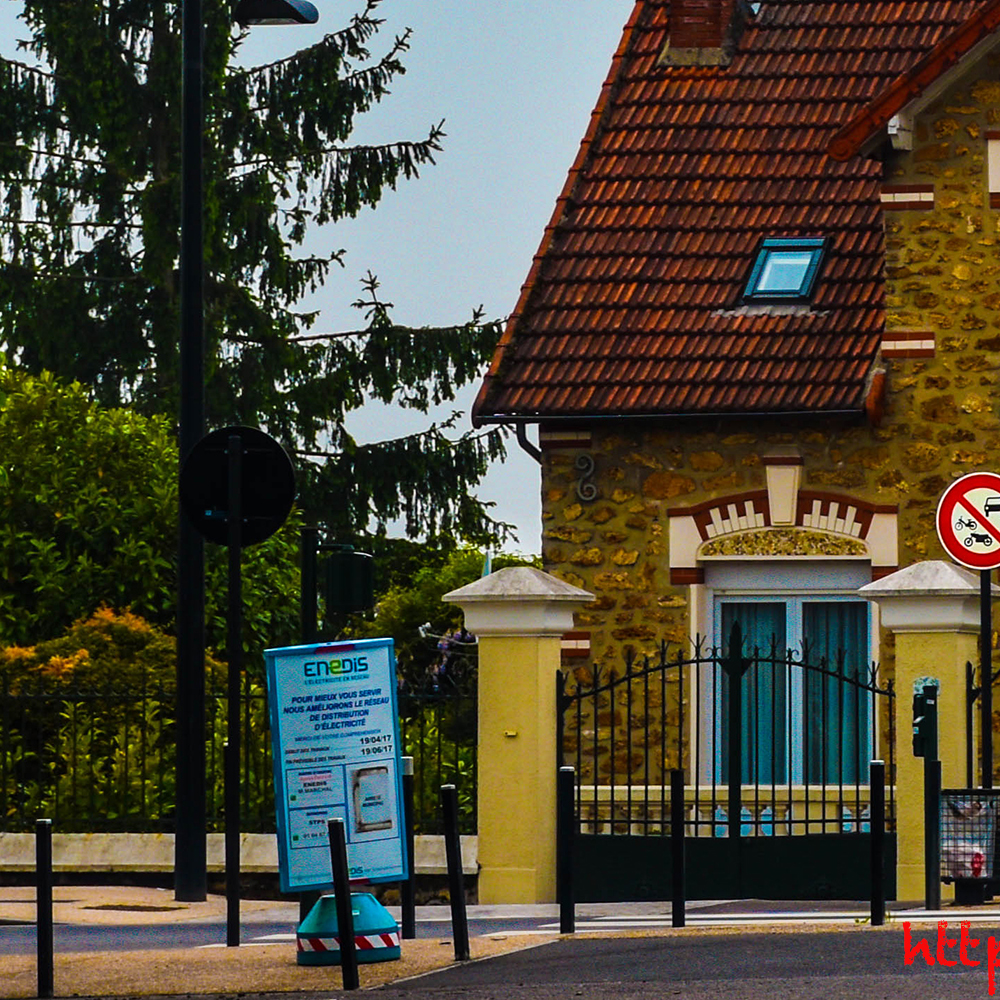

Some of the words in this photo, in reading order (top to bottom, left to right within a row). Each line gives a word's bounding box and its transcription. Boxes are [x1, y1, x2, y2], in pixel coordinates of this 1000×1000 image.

[291, 695, 313, 704] POUR
[315, 693, 337, 702] MIEUX
[339, 691, 358, 700] VOUS
[359, 688, 382, 697] SERVIR
[283, 706, 305, 714] NOUS
[354, 700, 363, 708] LE
[309, 714, 321, 722] DE
[321, 709, 370, 720] DISTRIBUTION
[360, 734, 392, 745] 19/04/17
[361, 745, 393, 755] 19/06/17
